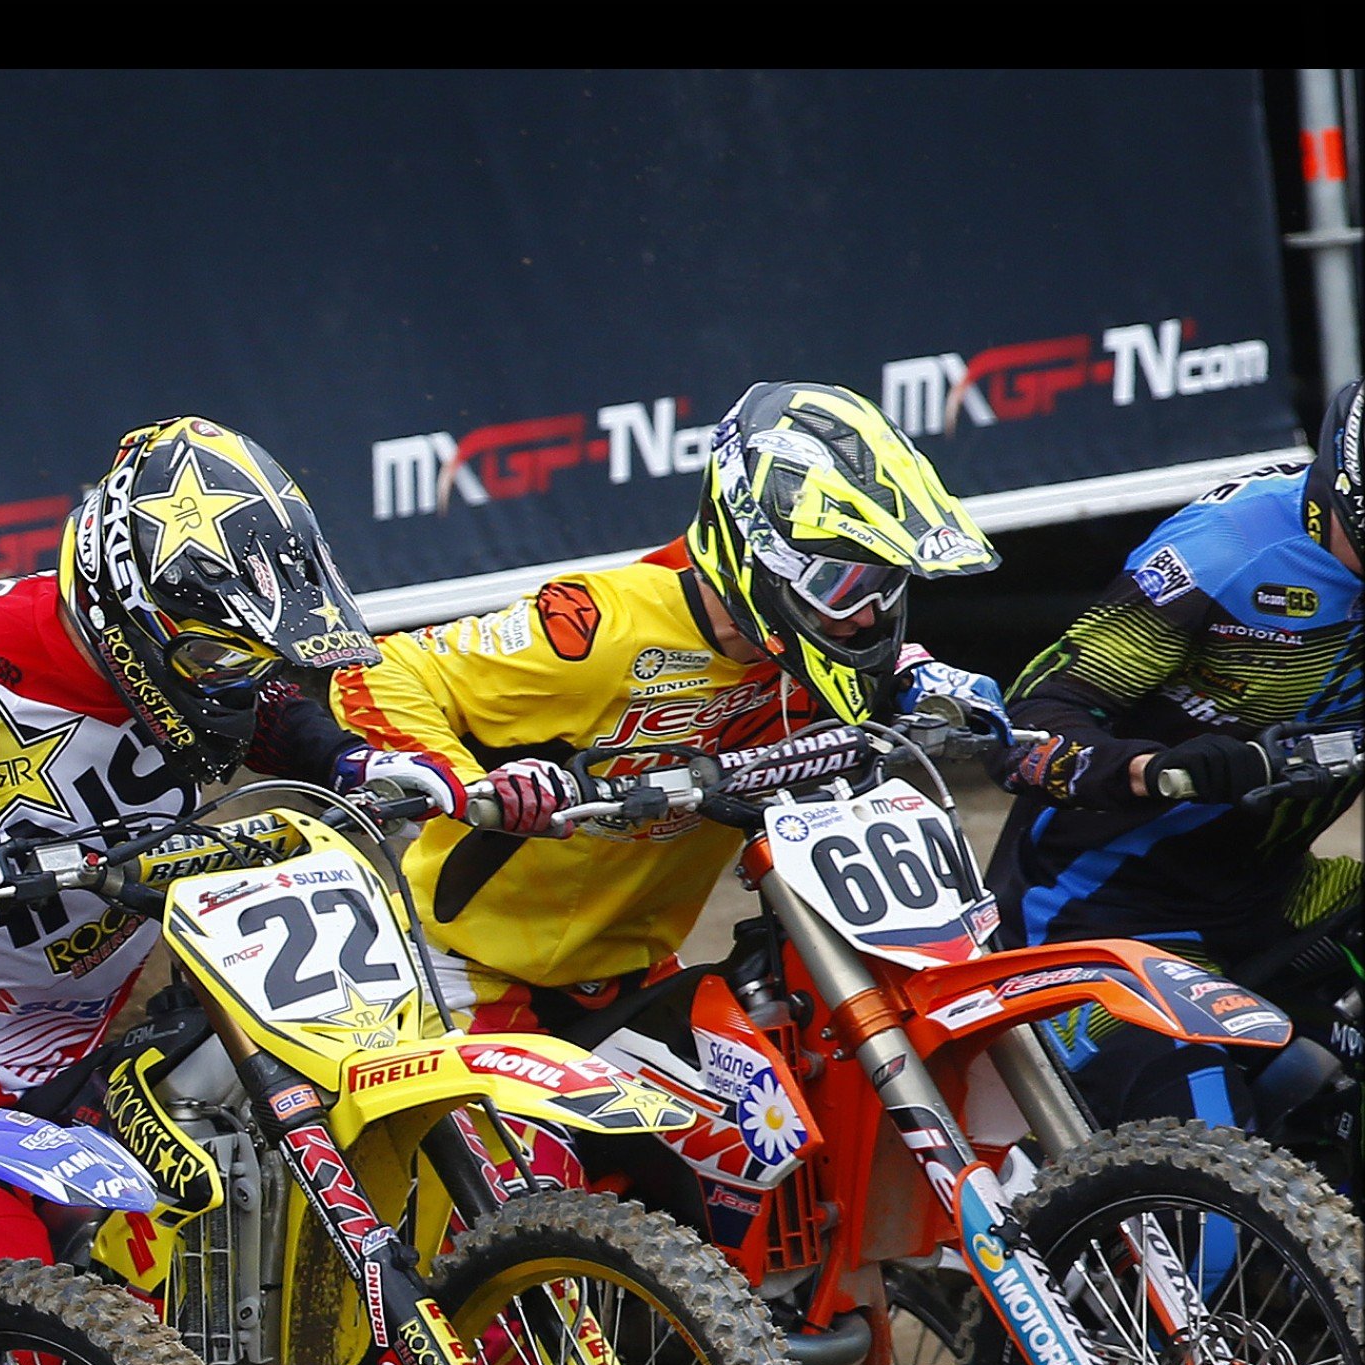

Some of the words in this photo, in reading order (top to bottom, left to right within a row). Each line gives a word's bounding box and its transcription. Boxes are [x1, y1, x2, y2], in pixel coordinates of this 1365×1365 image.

[103, 465, 159, 613] OAKLEY
[645, 679, 710, 696] DUNLOP
[718, 726, 858, 770] RENTHAL
[727, 750, 863, 794] RENTHAL
[802, 805, 840, 823] Skåne
[870, 795, 926, 816] MXGP
[292, 868, 356, 887] SUZUKI
[811, 817, 975, 926] 664
[222, 943, 265, 969] MXGP
[237, 888, 401, 1011] 22
[348, 1050, 447, 1093] PIRELLI
[471, 1049, 567, 1088] MOTUL
[707, 1040, 755, 1080] Skåne
[276, 1089, 317, 1113] GET
[365, 1263, 388, 1347] BRAKING
